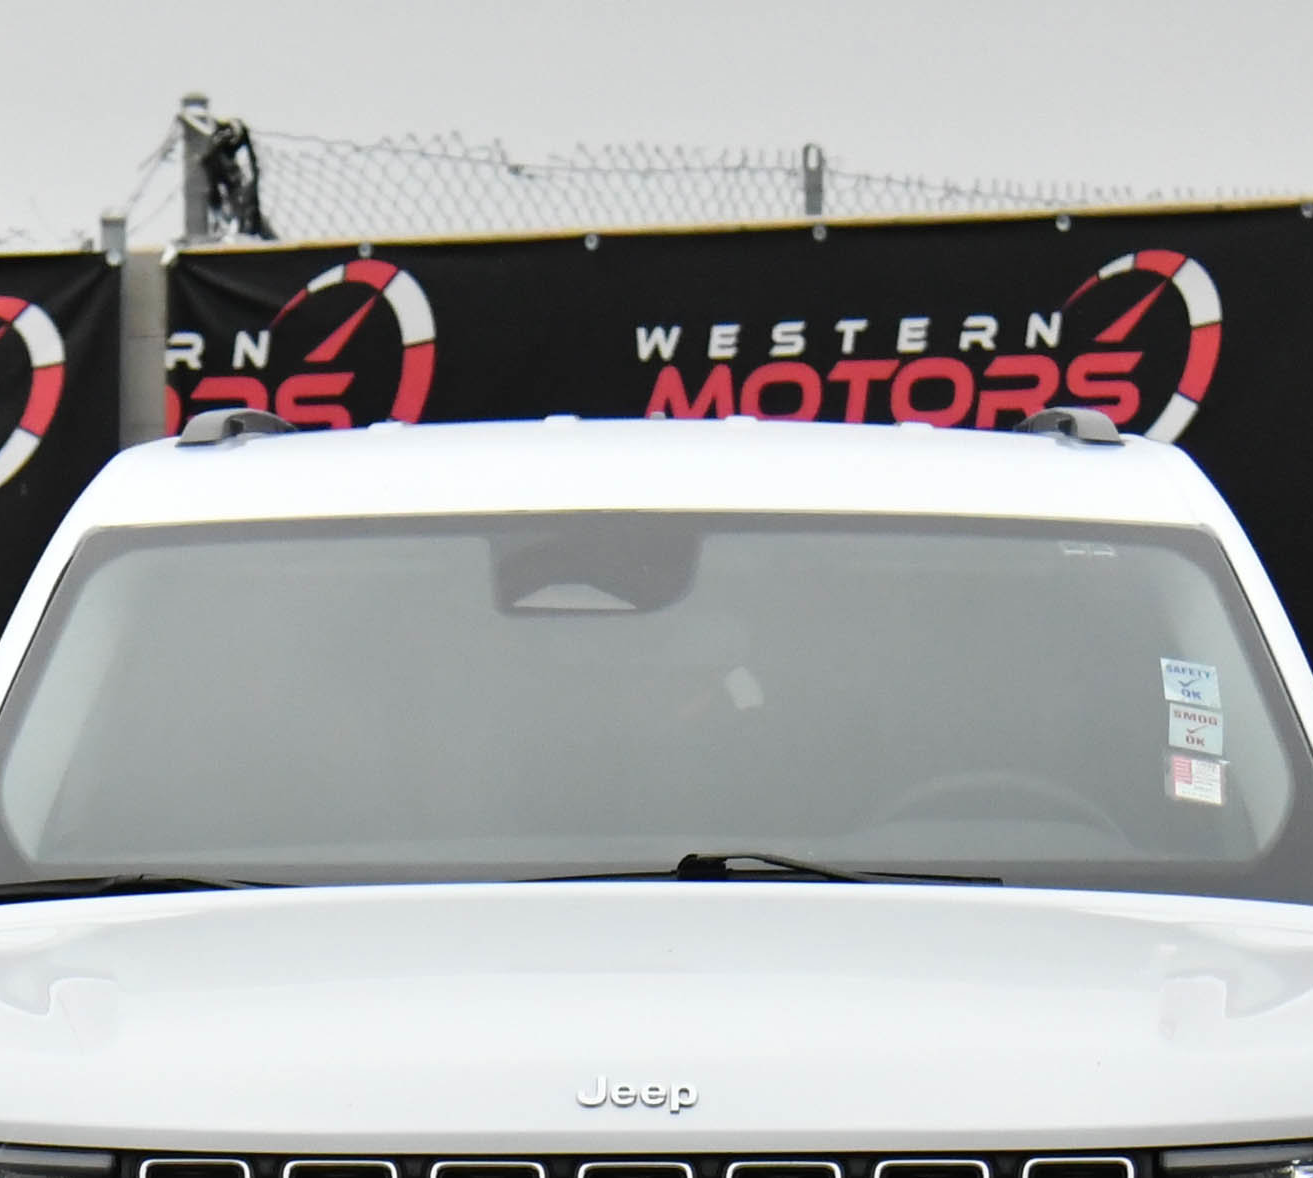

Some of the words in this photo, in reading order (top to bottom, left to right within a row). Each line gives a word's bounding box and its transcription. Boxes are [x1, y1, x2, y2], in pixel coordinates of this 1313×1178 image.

[636, 312, 1062, 362] WESTERN
[645, 351, 1143, 430] MOTORS
[1166, 664, 1211, 680] SAFETY
[1181, 688, 1202, 700] OK
[1186, 735, 1205, 747] OK
[576, 1074, 700, 1114] Jeep
